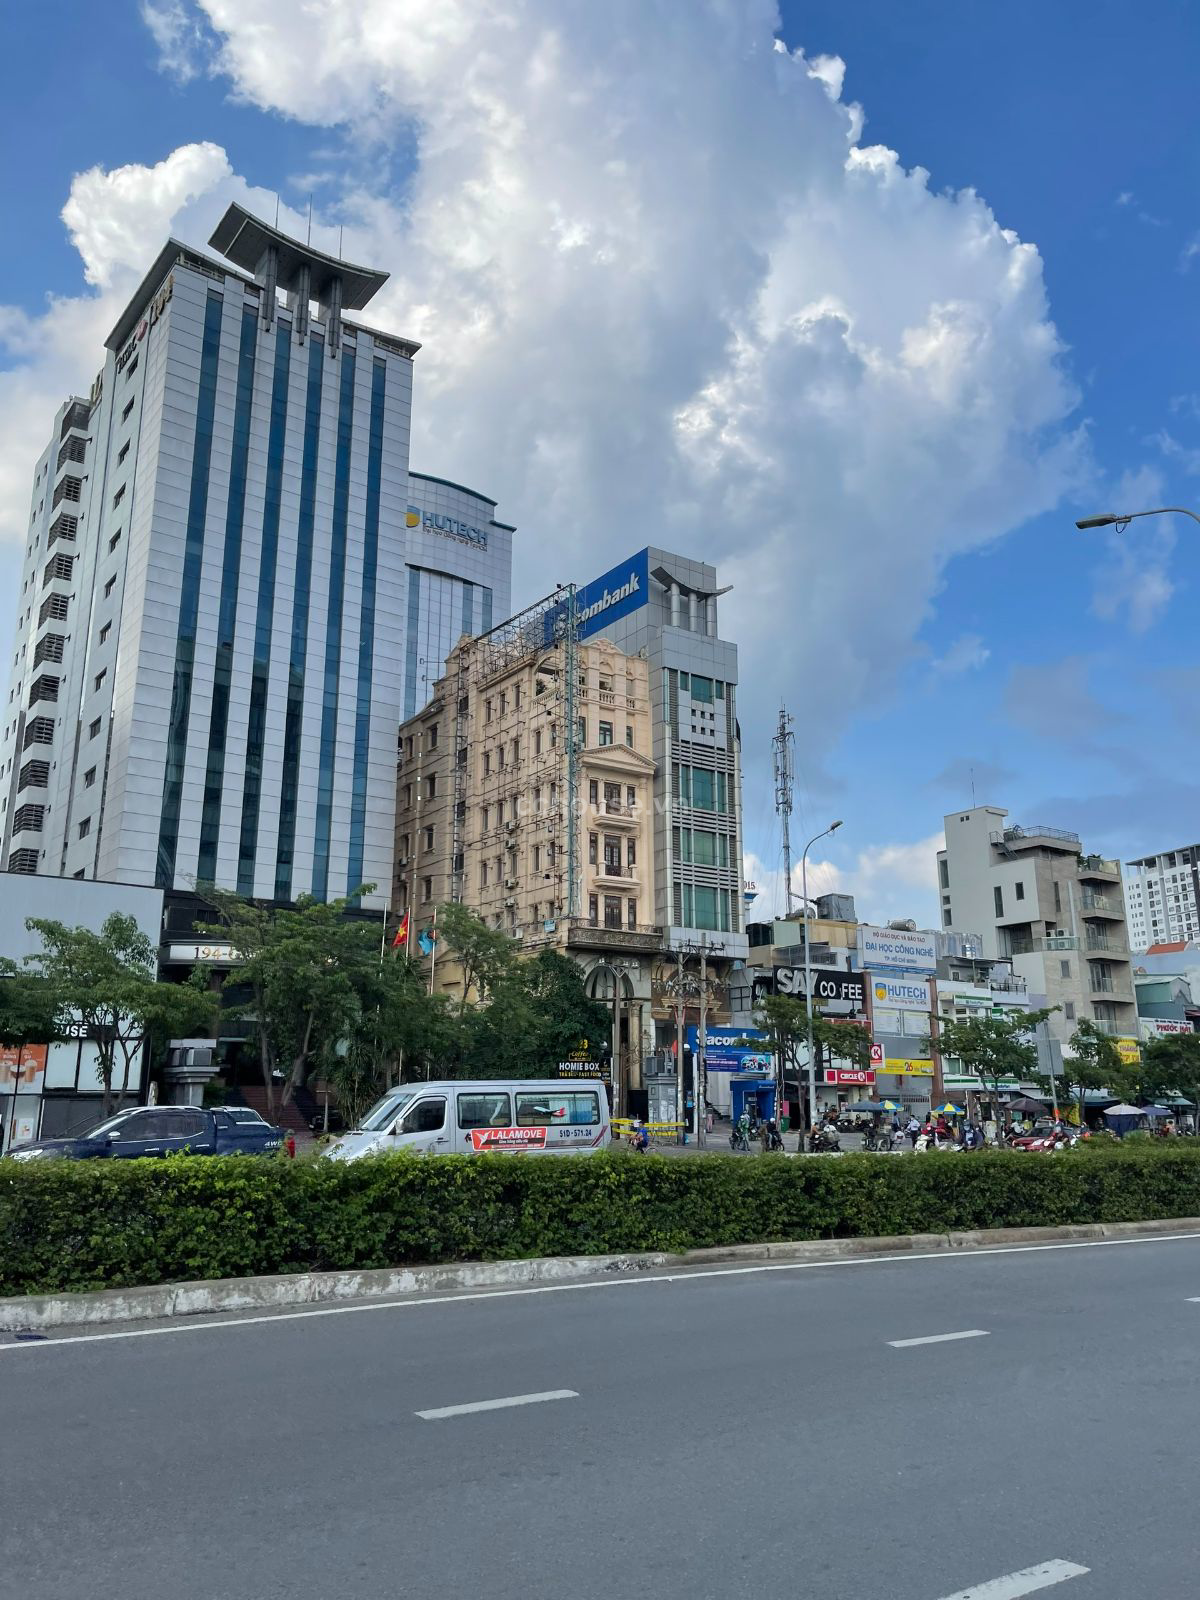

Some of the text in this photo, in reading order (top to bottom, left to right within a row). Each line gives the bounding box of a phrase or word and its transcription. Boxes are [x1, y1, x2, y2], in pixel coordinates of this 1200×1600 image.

[422, 511, 488, 546] HUTECH
[865, 941, 878, 951] ĐẠI
[878, 943, 893, 953] HỌC
[895, 944, 915, 955] CÔNG
[776, 967, 819, 995] SAY
[887, 984, 927, 999] HUTECH
[559, 1062, 600, 1071] HOMIE BOX
[491, 1129, 543, 1140] LALAMOVE
